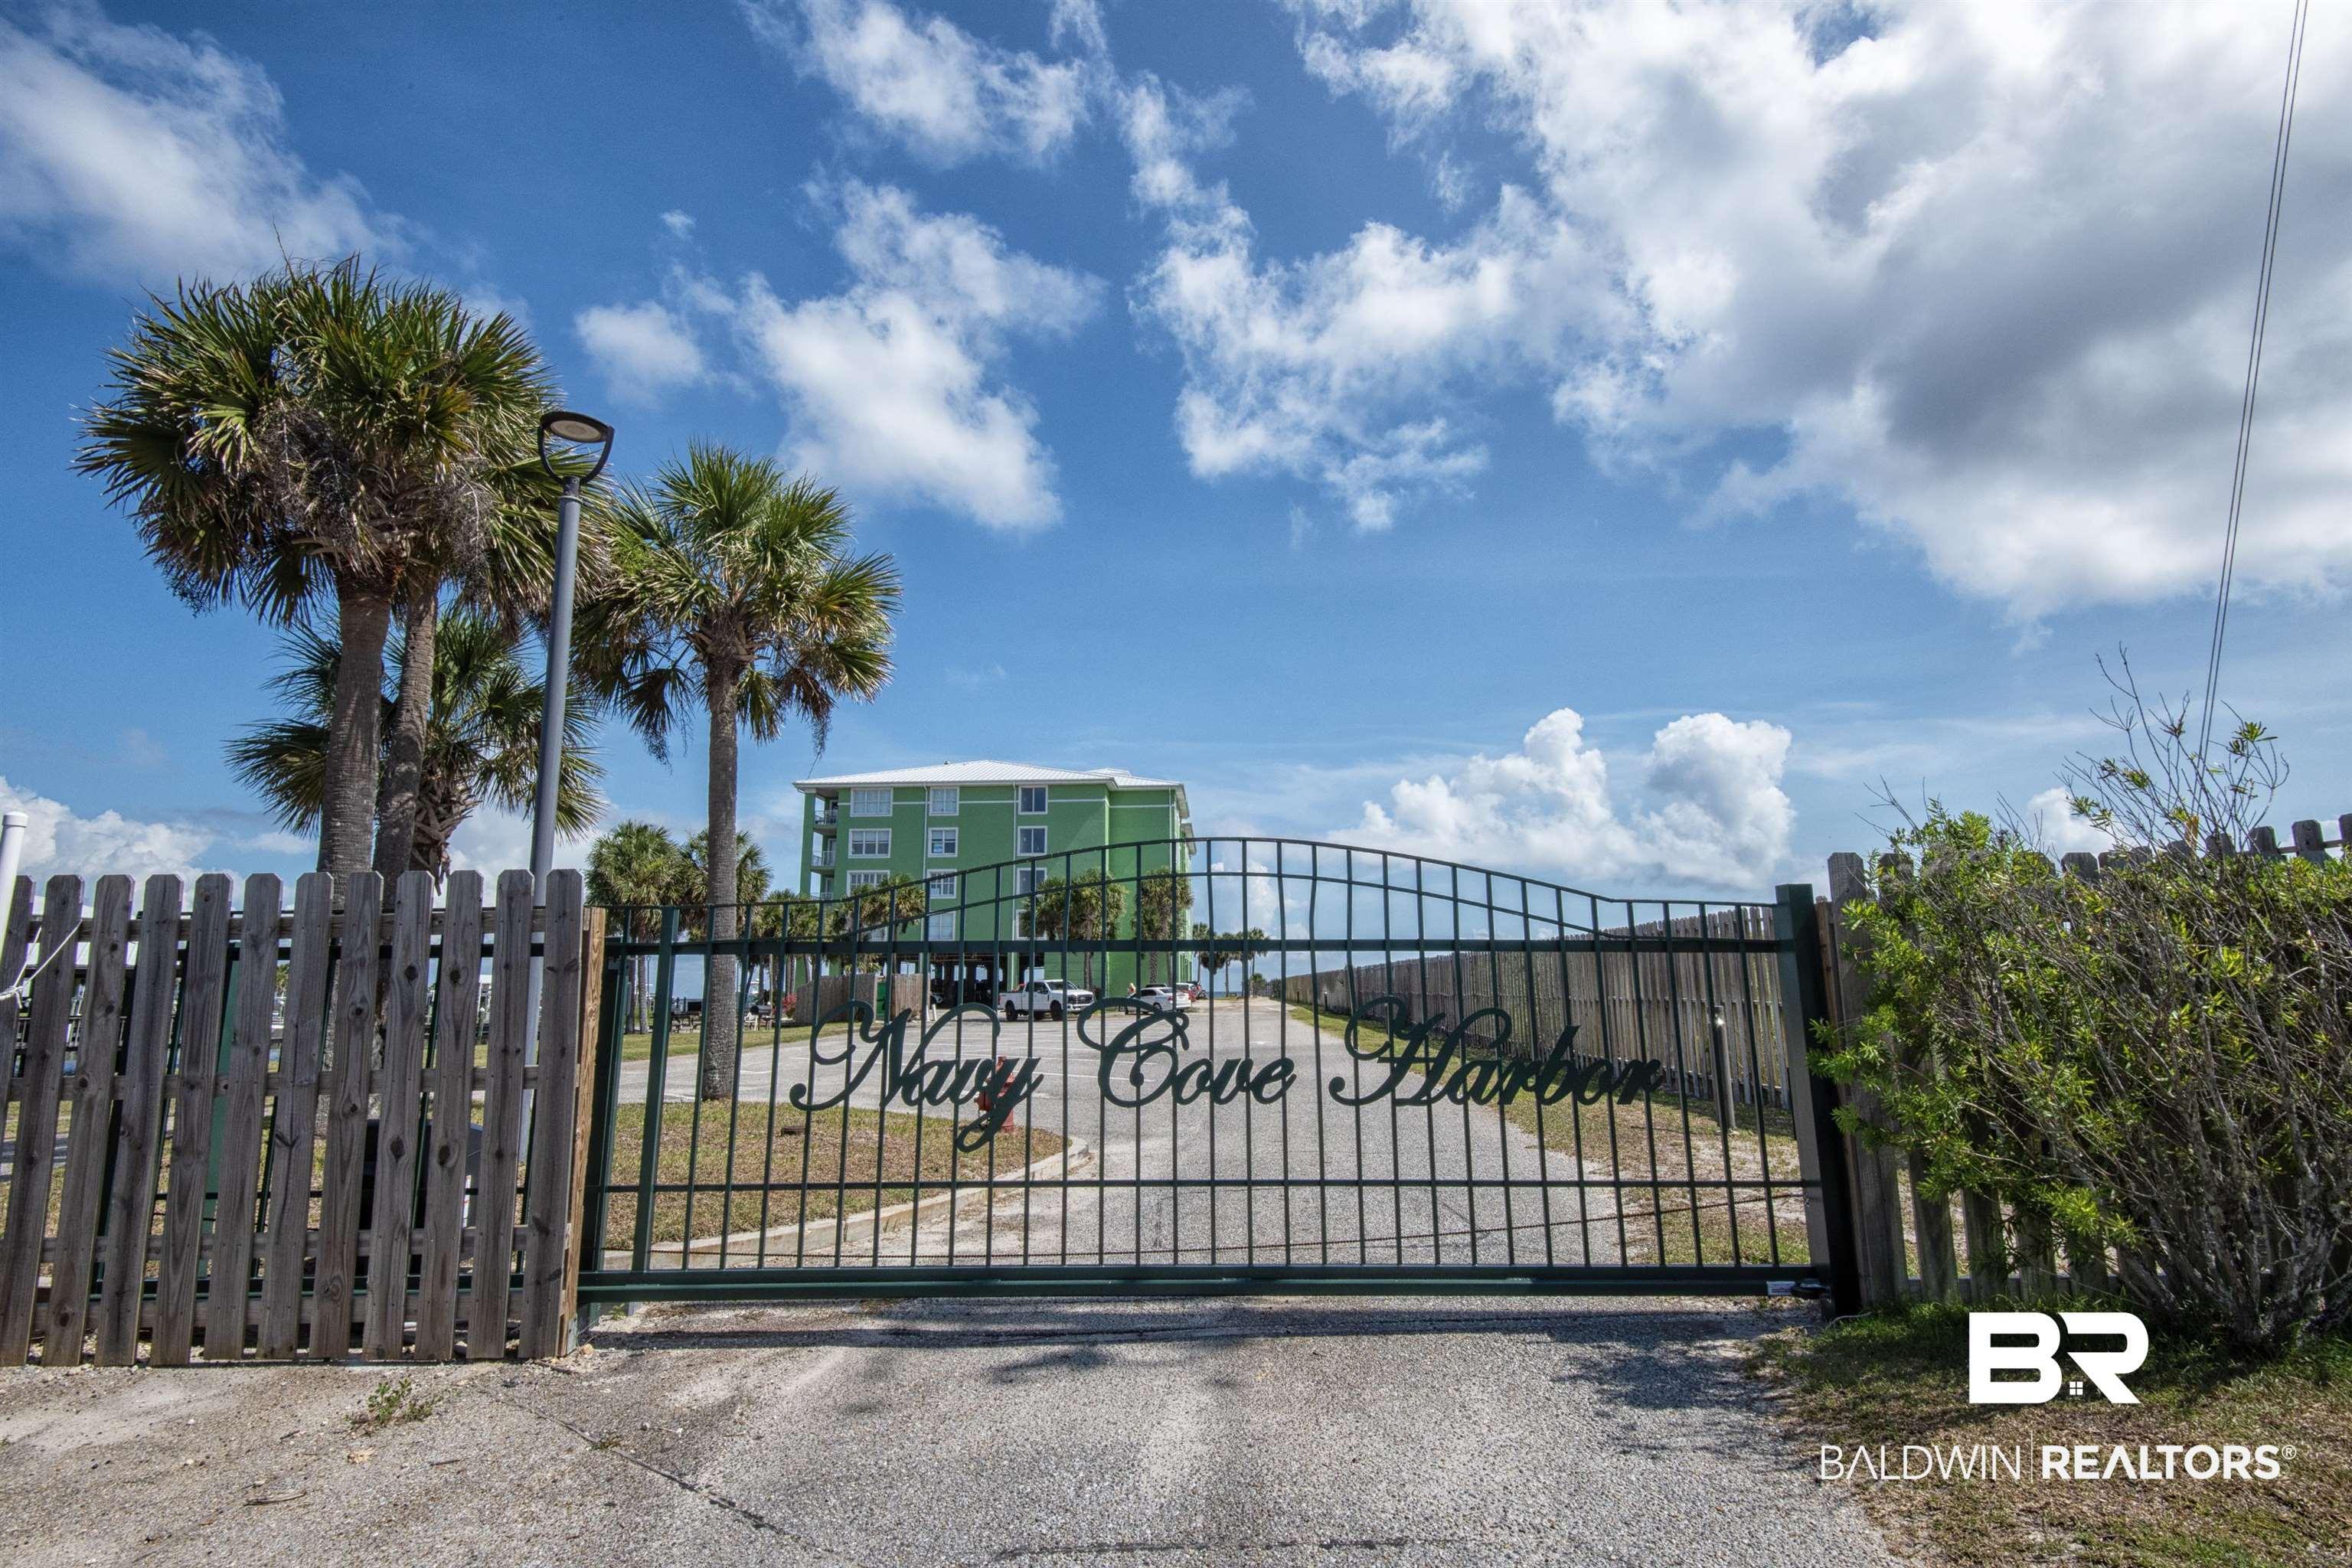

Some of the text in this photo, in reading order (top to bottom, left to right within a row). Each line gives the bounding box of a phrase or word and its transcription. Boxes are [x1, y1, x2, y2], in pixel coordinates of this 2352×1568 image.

[789, 996, 1663, 1152] Navy Cove Harbor
